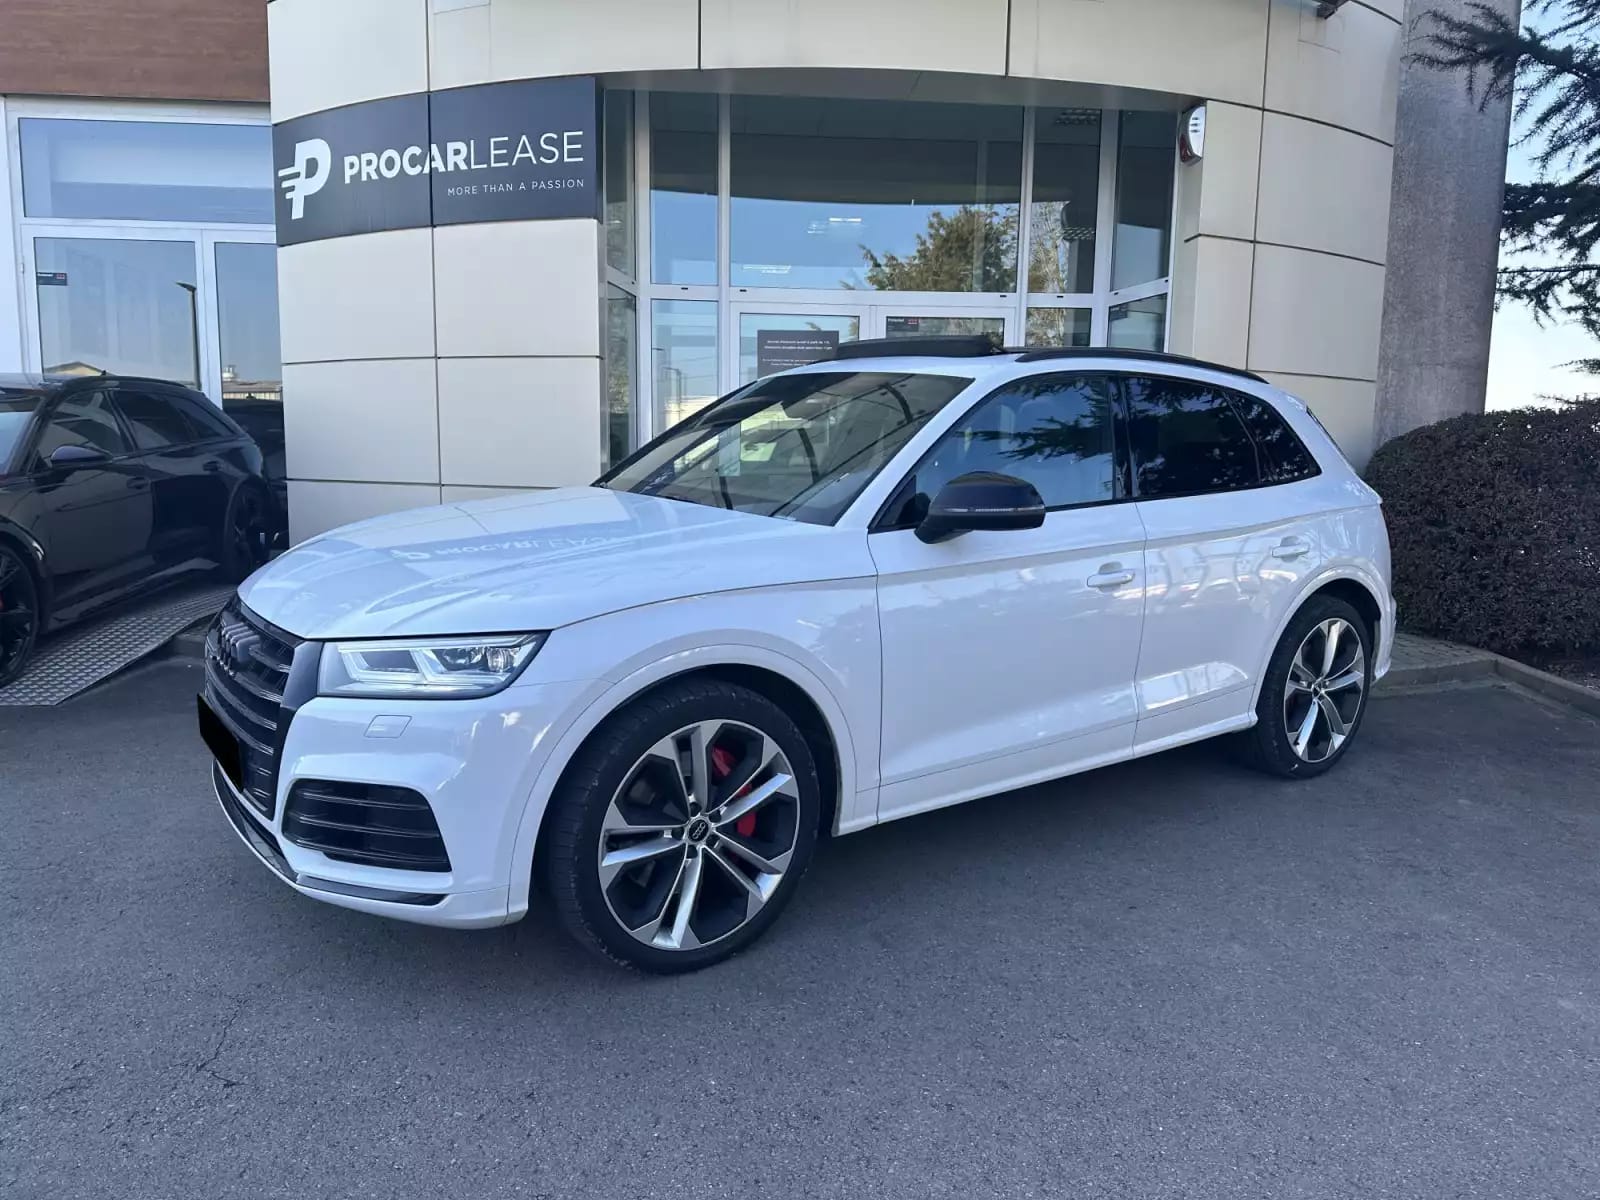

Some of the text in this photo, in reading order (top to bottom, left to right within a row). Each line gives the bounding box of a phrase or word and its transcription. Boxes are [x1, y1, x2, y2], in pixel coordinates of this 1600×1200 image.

[343, 130, 584, 184] PROCARLEASE
[447, 179, 584, 197] MORE THAN A PASSION
